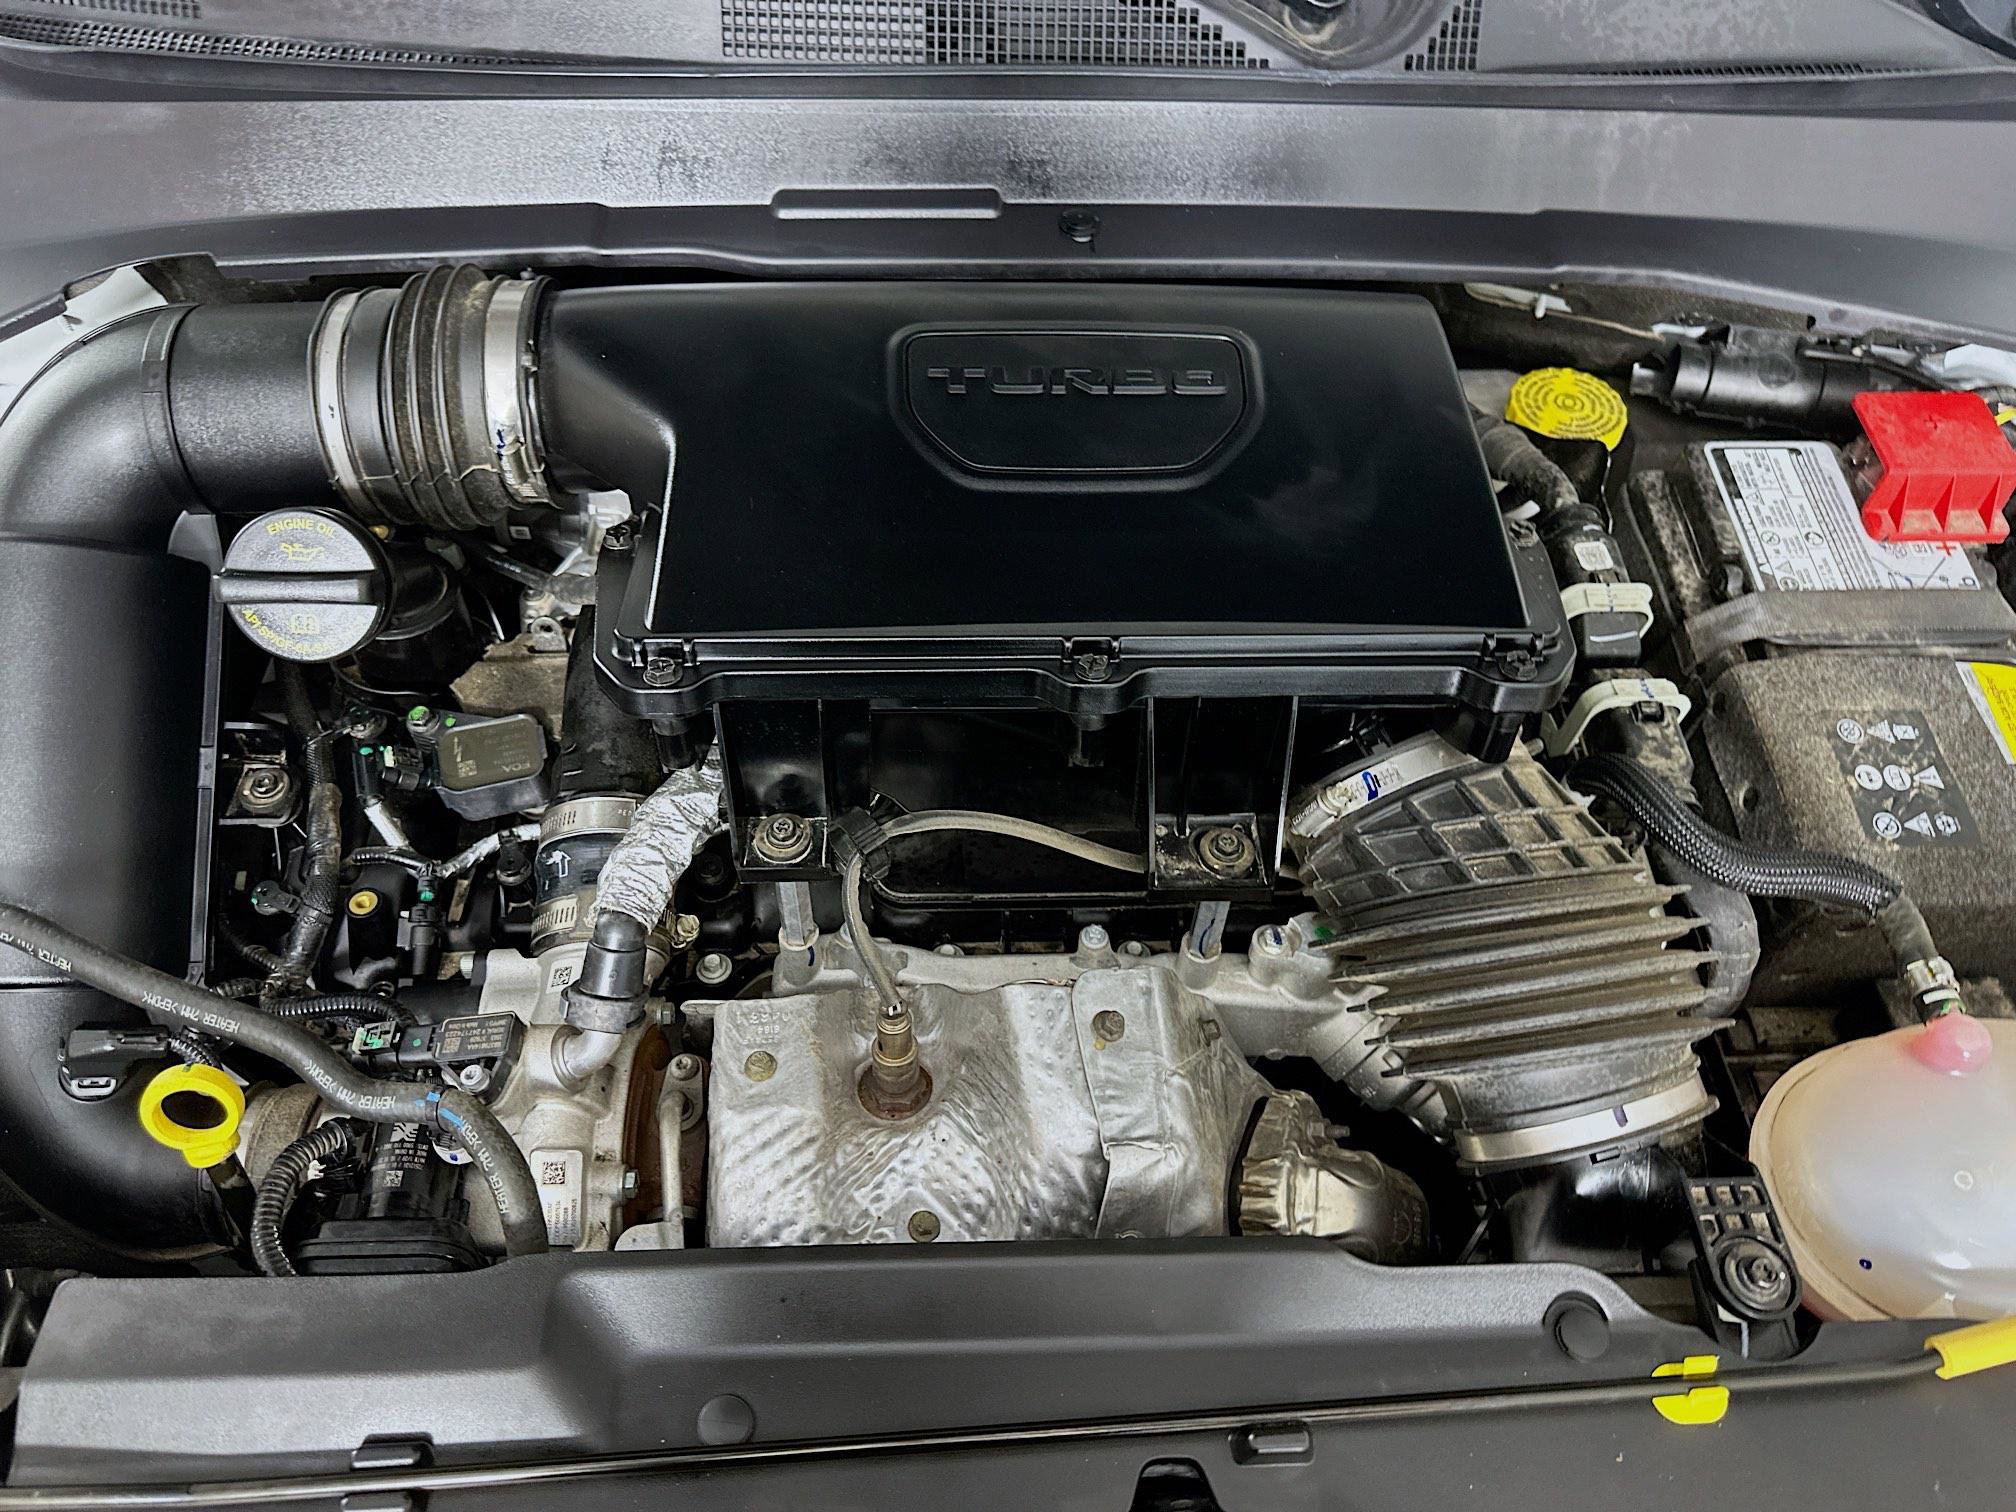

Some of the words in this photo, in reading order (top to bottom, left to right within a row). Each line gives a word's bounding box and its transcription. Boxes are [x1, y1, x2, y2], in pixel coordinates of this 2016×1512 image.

[927, 366, 1227, 395] TURBO
[266, 518, 315, 535] ENGINE
[316, 522, 335, 539] OIL
[242, 608, 262, 629] API
[181, 1000, 201, 1021] 7MM
[202, 1011, 240, 1034] HEATER
[336, 1084, 357, 1105] 7MM
[358, 1096, 396, 1111] HEATER
[477, 1147, 495, 1172] 7MM
[488, 1173, 509, 1214] HEATER
